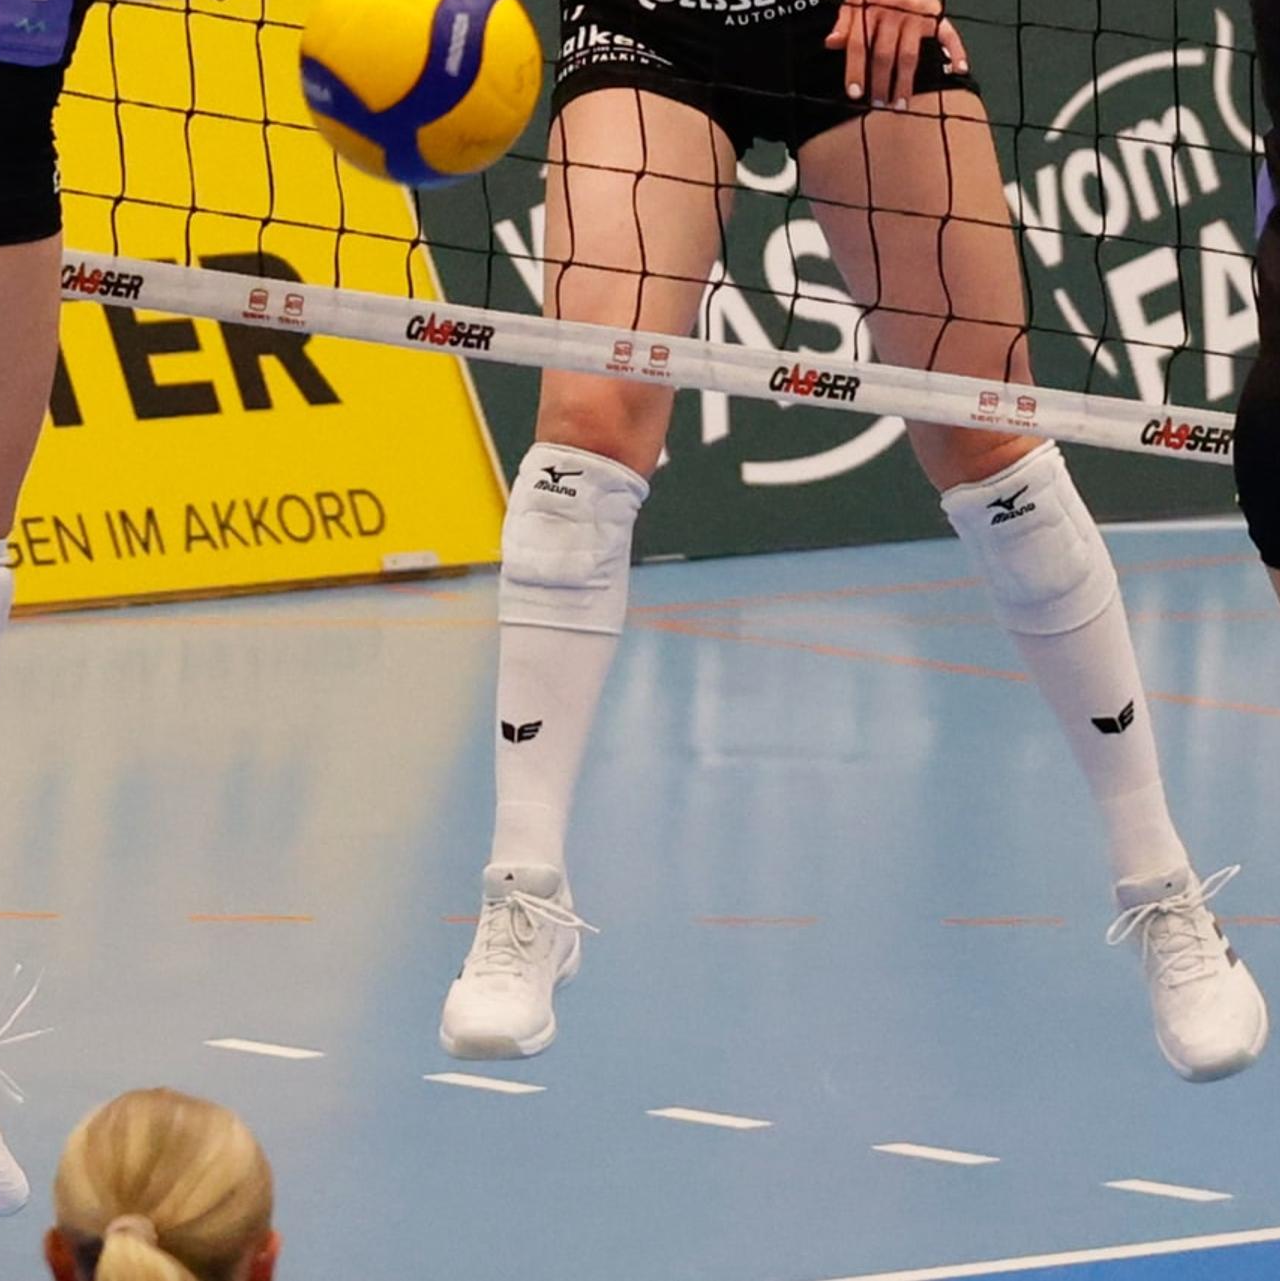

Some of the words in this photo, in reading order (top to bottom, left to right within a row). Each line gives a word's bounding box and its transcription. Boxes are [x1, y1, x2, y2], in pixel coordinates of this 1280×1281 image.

[1005, 105, 1220, 269] vom
[61, 261, 144, 300] GASSER
[1106, 219, 1260, 403] FA
[406, 312, 495, 351] GASSER
[769, 363, 861, 401] GASSER
[1140, 416, 1234, 455] GASSER
[104, 506, 163, 559] IM
[183, 487, 388, 553] AKKORD
